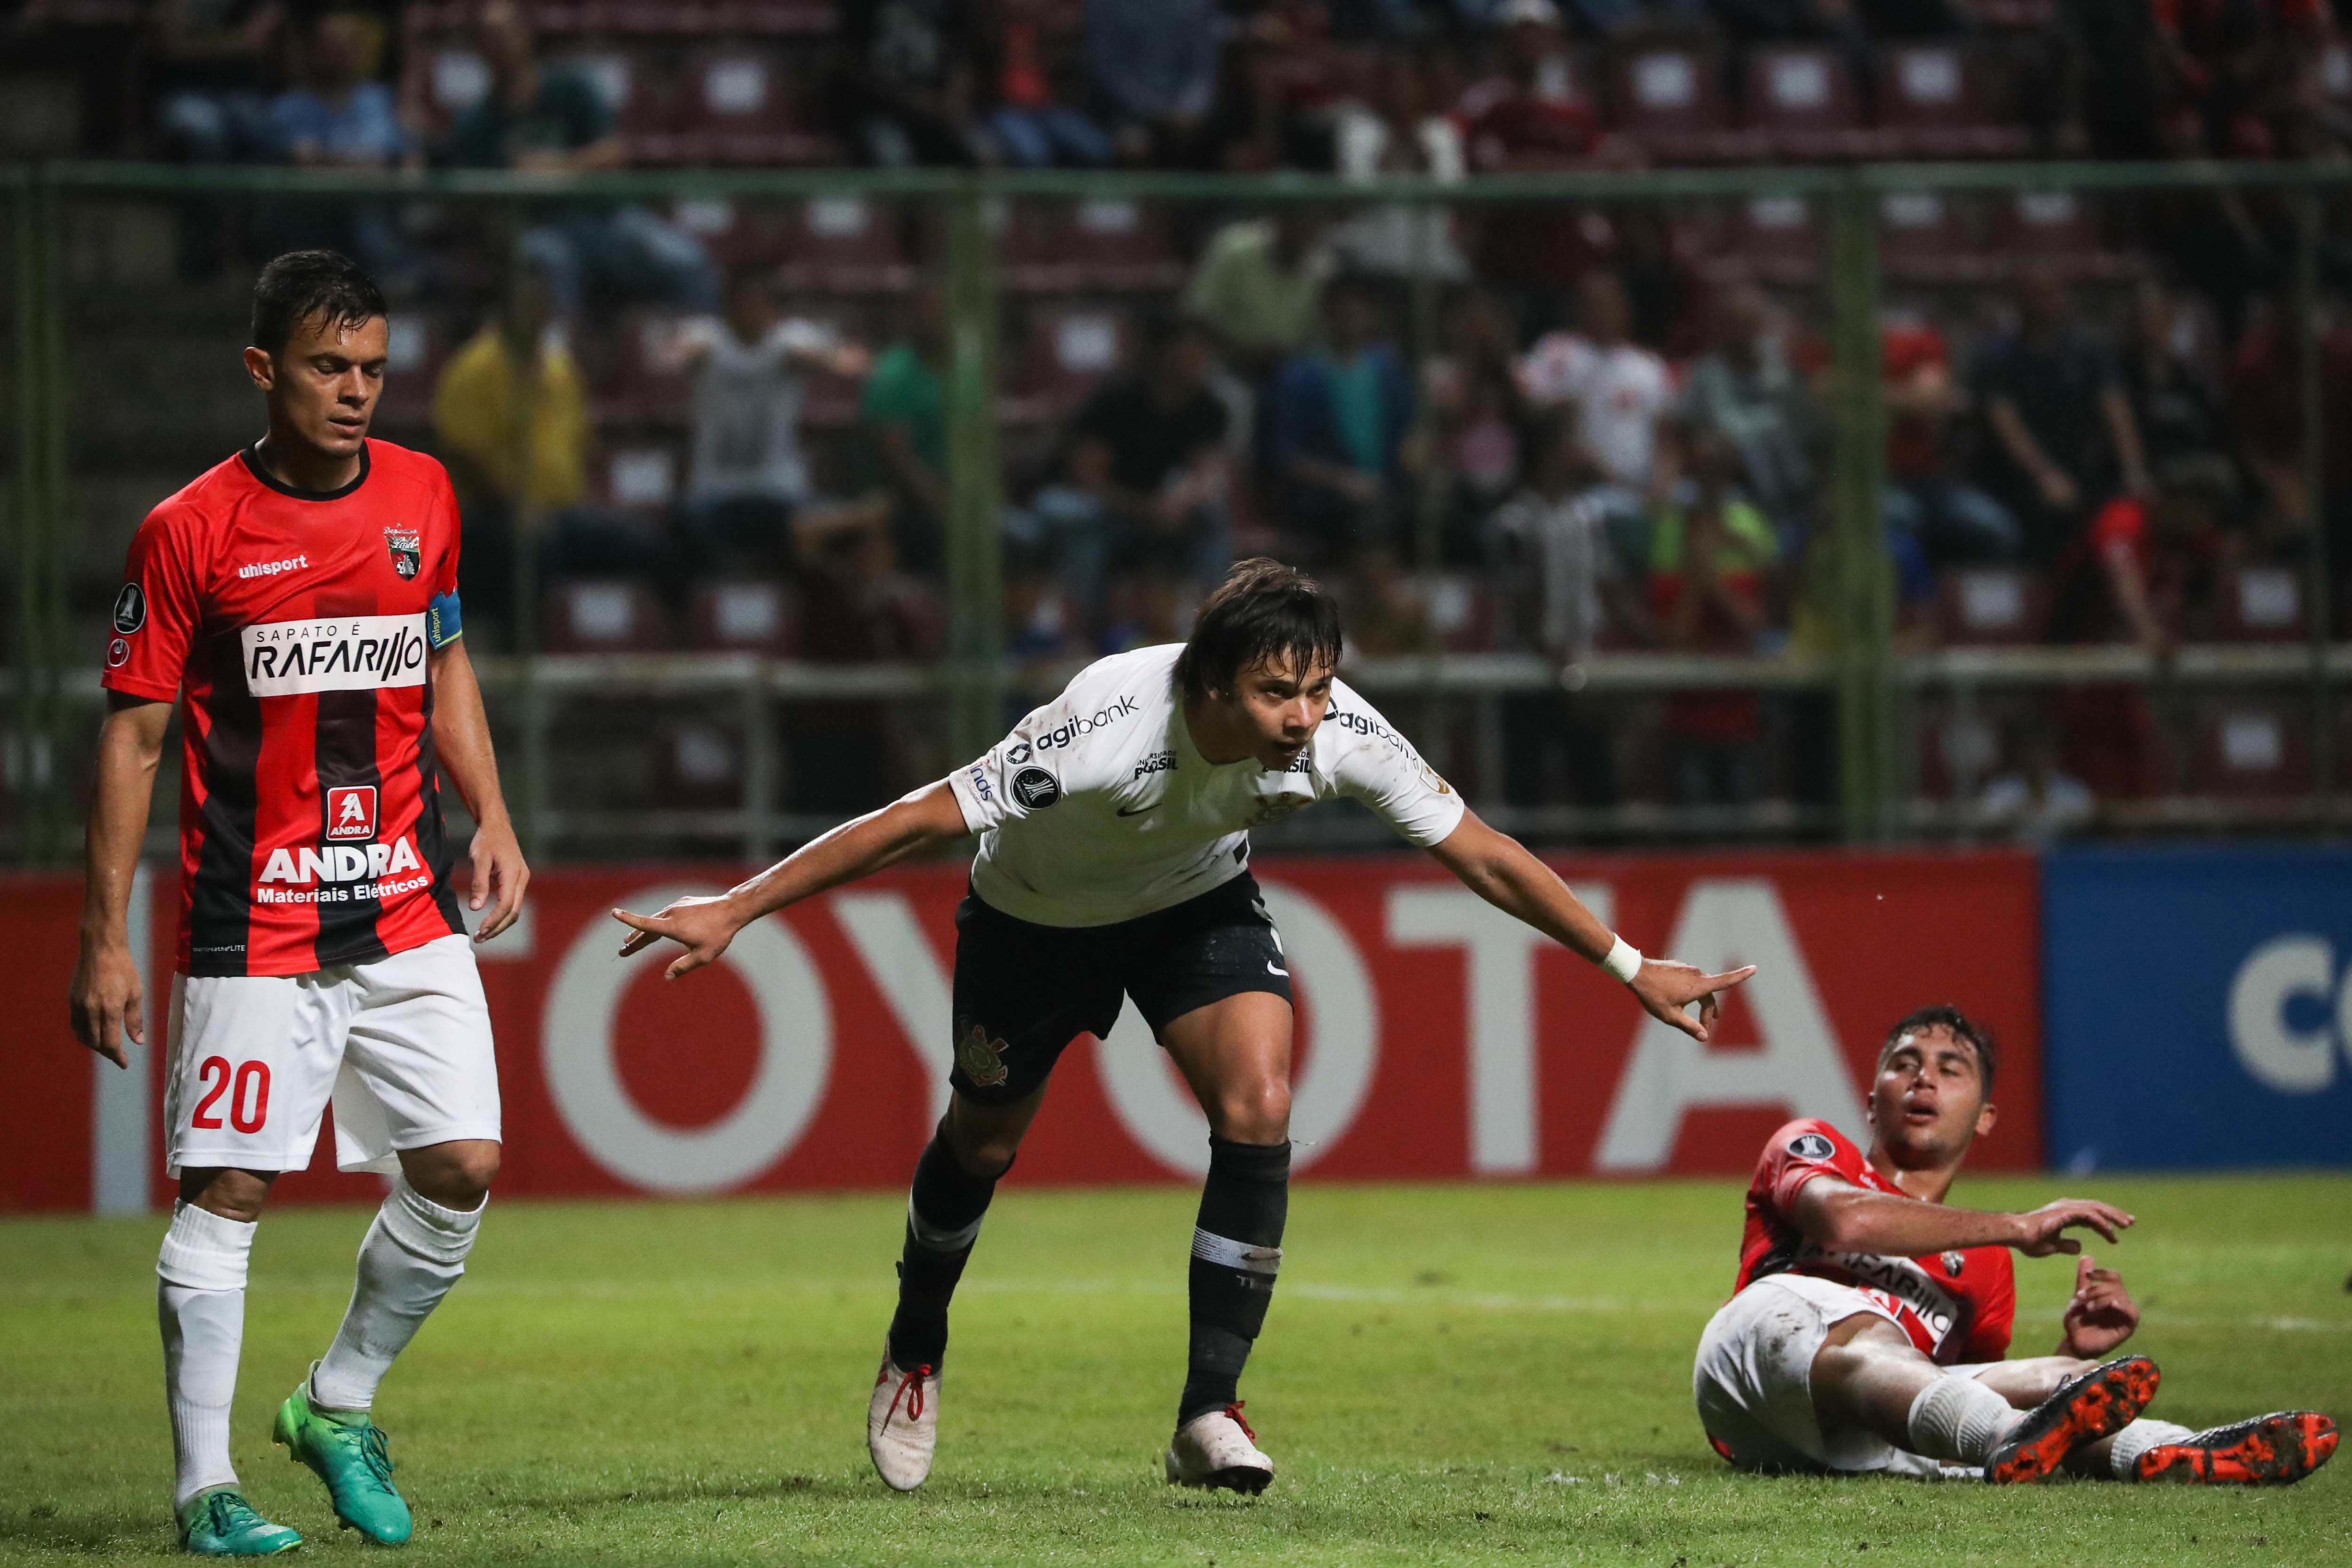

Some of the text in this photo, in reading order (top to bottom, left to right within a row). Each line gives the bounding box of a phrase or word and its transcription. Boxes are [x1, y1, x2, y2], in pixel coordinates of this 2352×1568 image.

[238, 554, 309, 579] uhlsport
[256, 621, 360, 643] SAPATO É
[430, 607, 441, 642] uhlsport
[1036, 695, 1139, 751] agibank
[969, 759, 995, 801] inds
[330, 825, 370, 836] ANDRA
[258, 836, 420, 883] ANDRA
[257, 876, 429, 903] Materiais Elétricos
[457, 878, 1870, 1190] OYOTA
[2227, 934, 2352, 1095] C
[191, 1055, 271, 1134] 20
